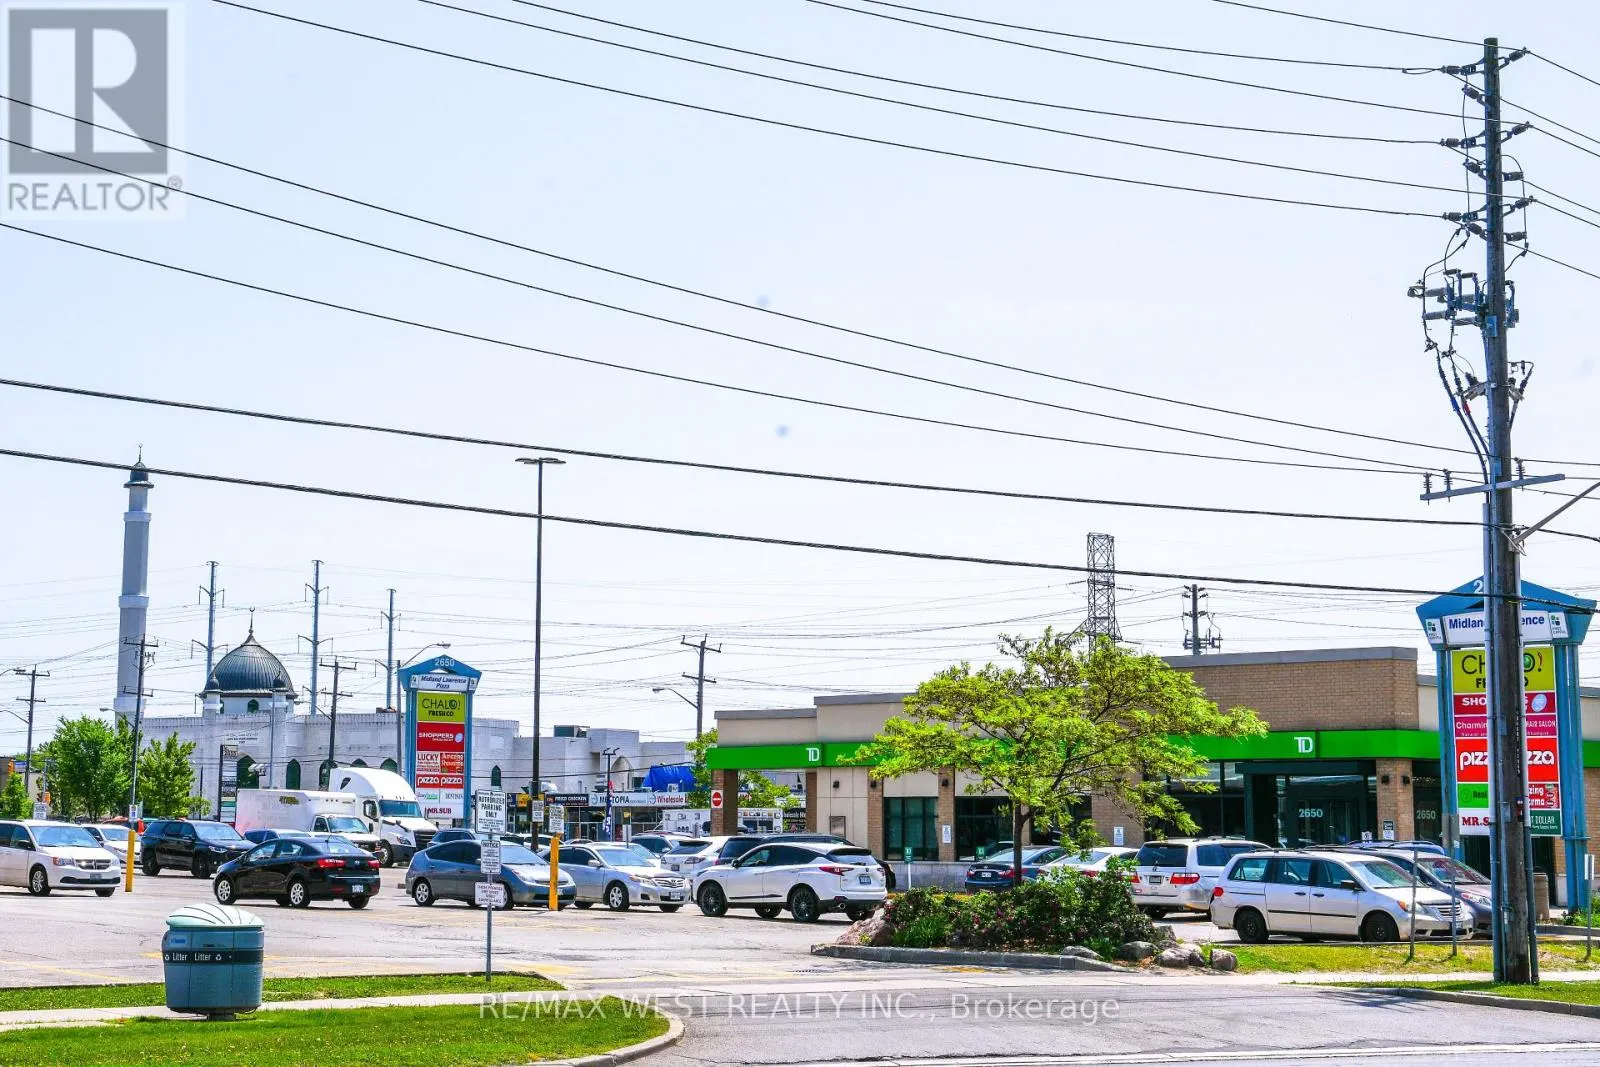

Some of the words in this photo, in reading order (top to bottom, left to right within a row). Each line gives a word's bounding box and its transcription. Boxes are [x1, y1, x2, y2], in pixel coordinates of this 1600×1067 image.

[1448, 617, 1484, 629] Midlan
[434, 659, 455, 667] 2650
[1456, 721, 1488, 729] Charmin
[1293, 736, 1314, 753] TD
[805, 747, 820, 762] TD
[1460, 751, 1489, 771] pizz
[417, 776, 440, 786] pizza
[440, 776, 462, 787] pizza
[1529, 785, 1544, 796] zing
[1298, 808, 1324, 818] 2650
[1416, 809, 1436, 820] 2650
[1461, 816, 1490, 827] MR.S
[172, 952, 188, 961] Litter
[194, 952, 212, 961] Litter
